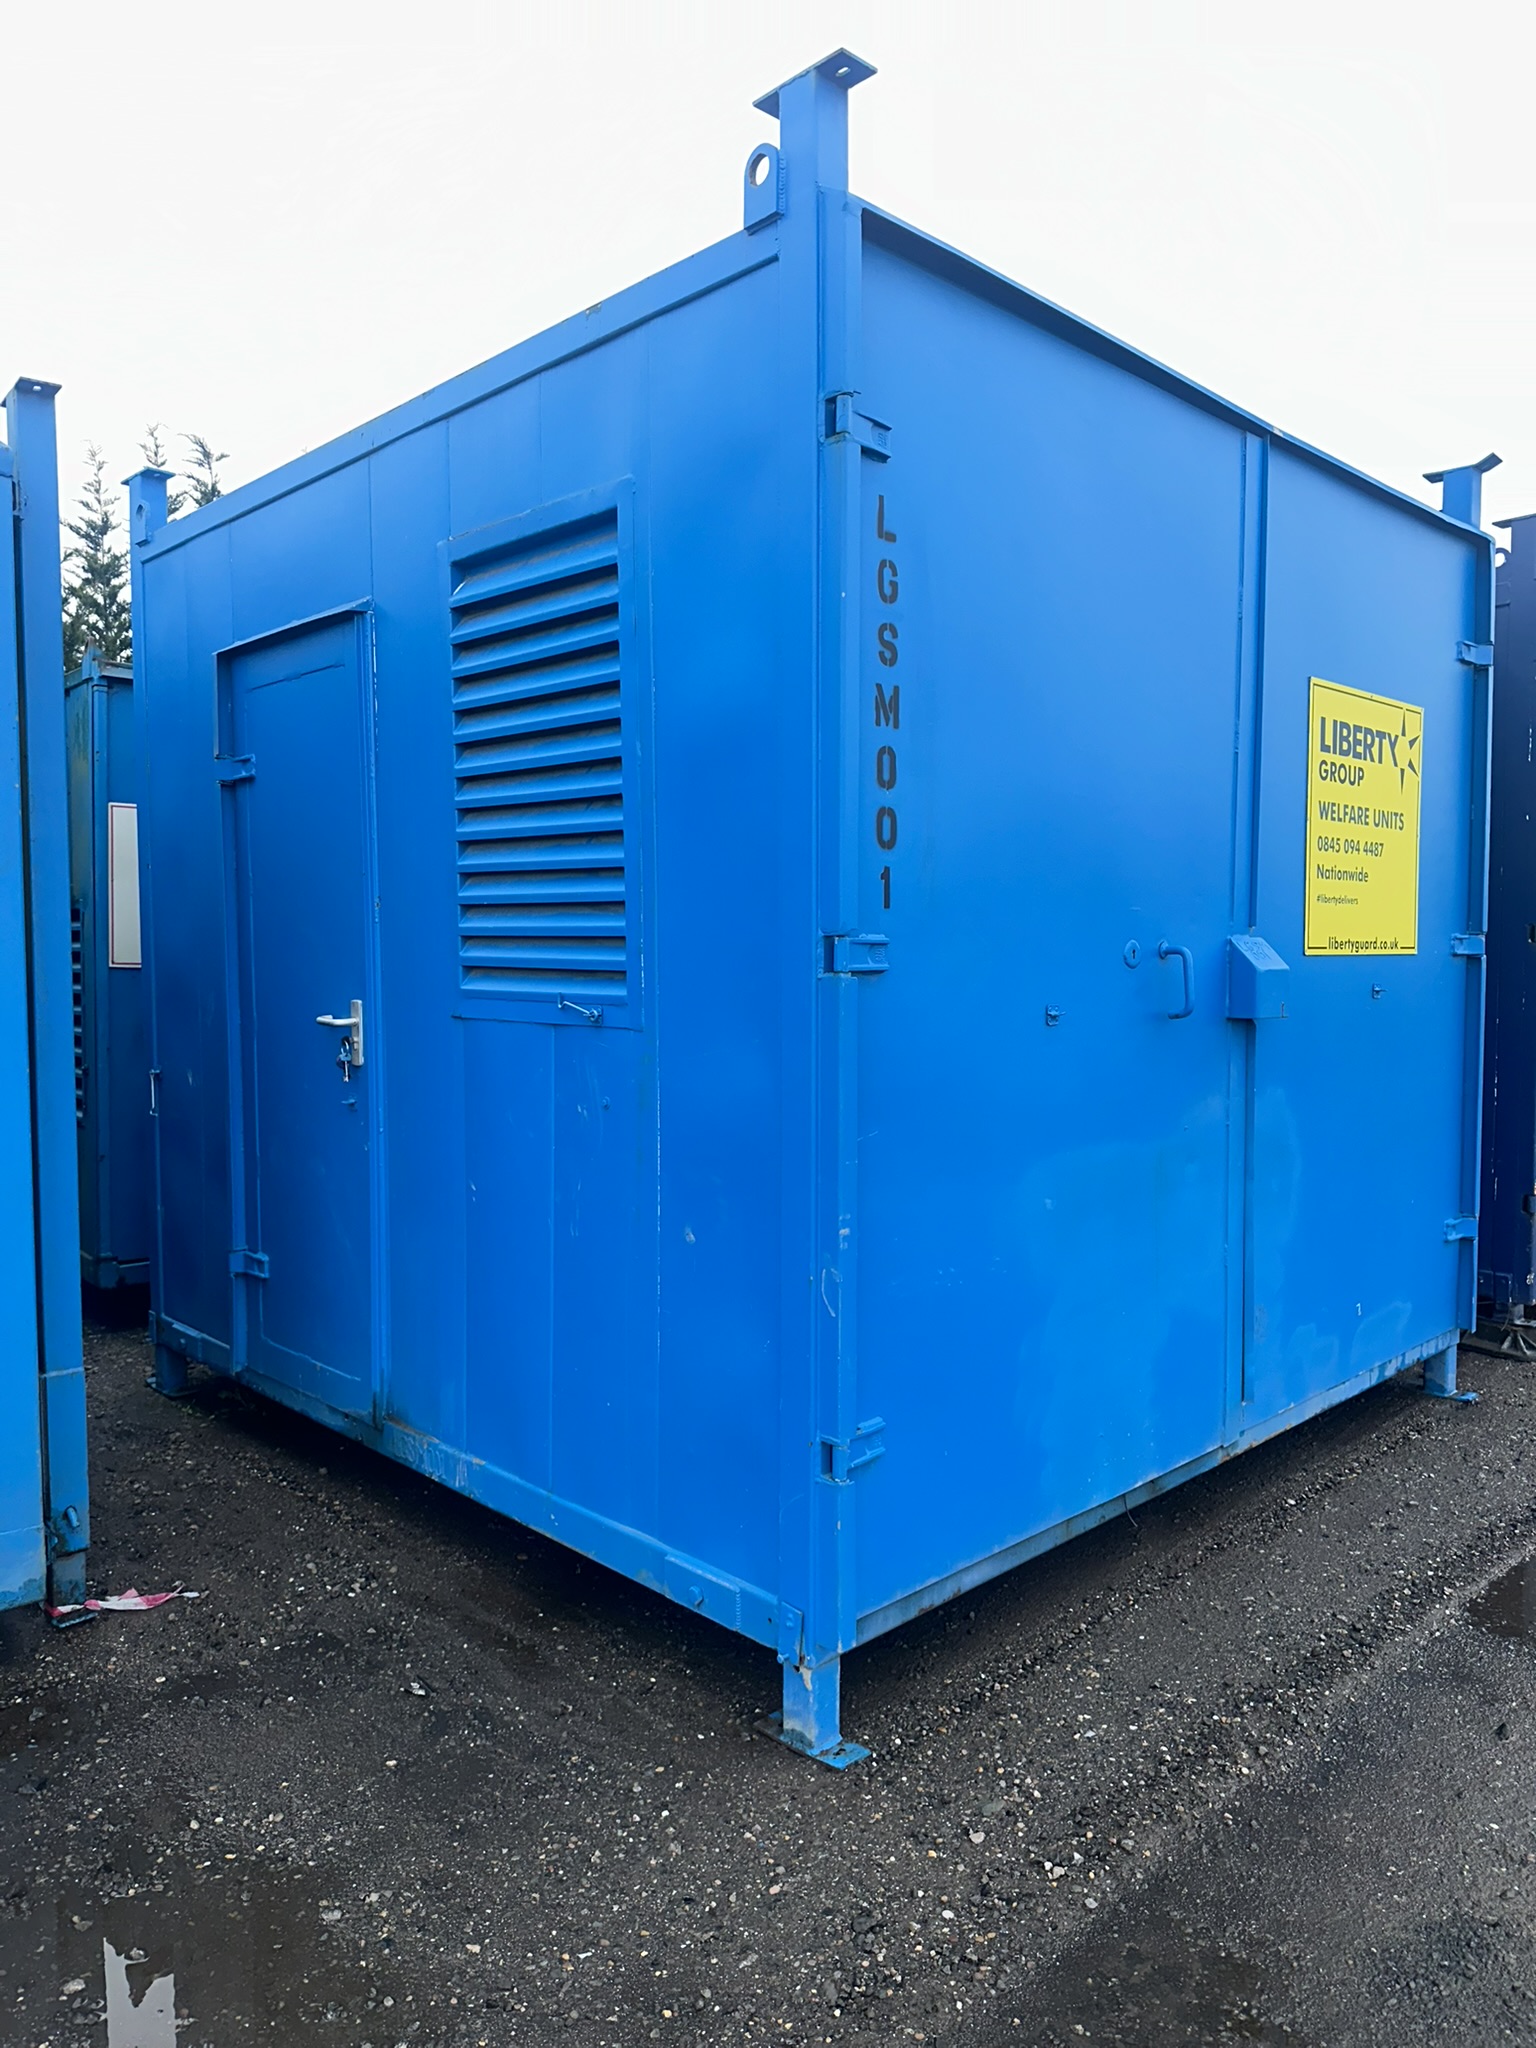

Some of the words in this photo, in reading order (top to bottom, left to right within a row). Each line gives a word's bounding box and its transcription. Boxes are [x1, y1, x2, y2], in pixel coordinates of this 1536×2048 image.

[1320, 716, 1399, 768] LIBERTY
[1318, 759, 1365, 787] GROUP
[1318, 800, 1370, 826] WELFARE
[1373, 808, 1405, 831] UNITS
[1317, 836, 1341, 854] 0845
[1344, 839, 1361, 855] 094
[1363, 841, 1384, 857] 4487
[1316, 863, 1369, 883] Nationwide
[1316, 894, 1359, 906] #libertydelivers
[1328, 936, 1399, 954] libertyguard.co.uk
